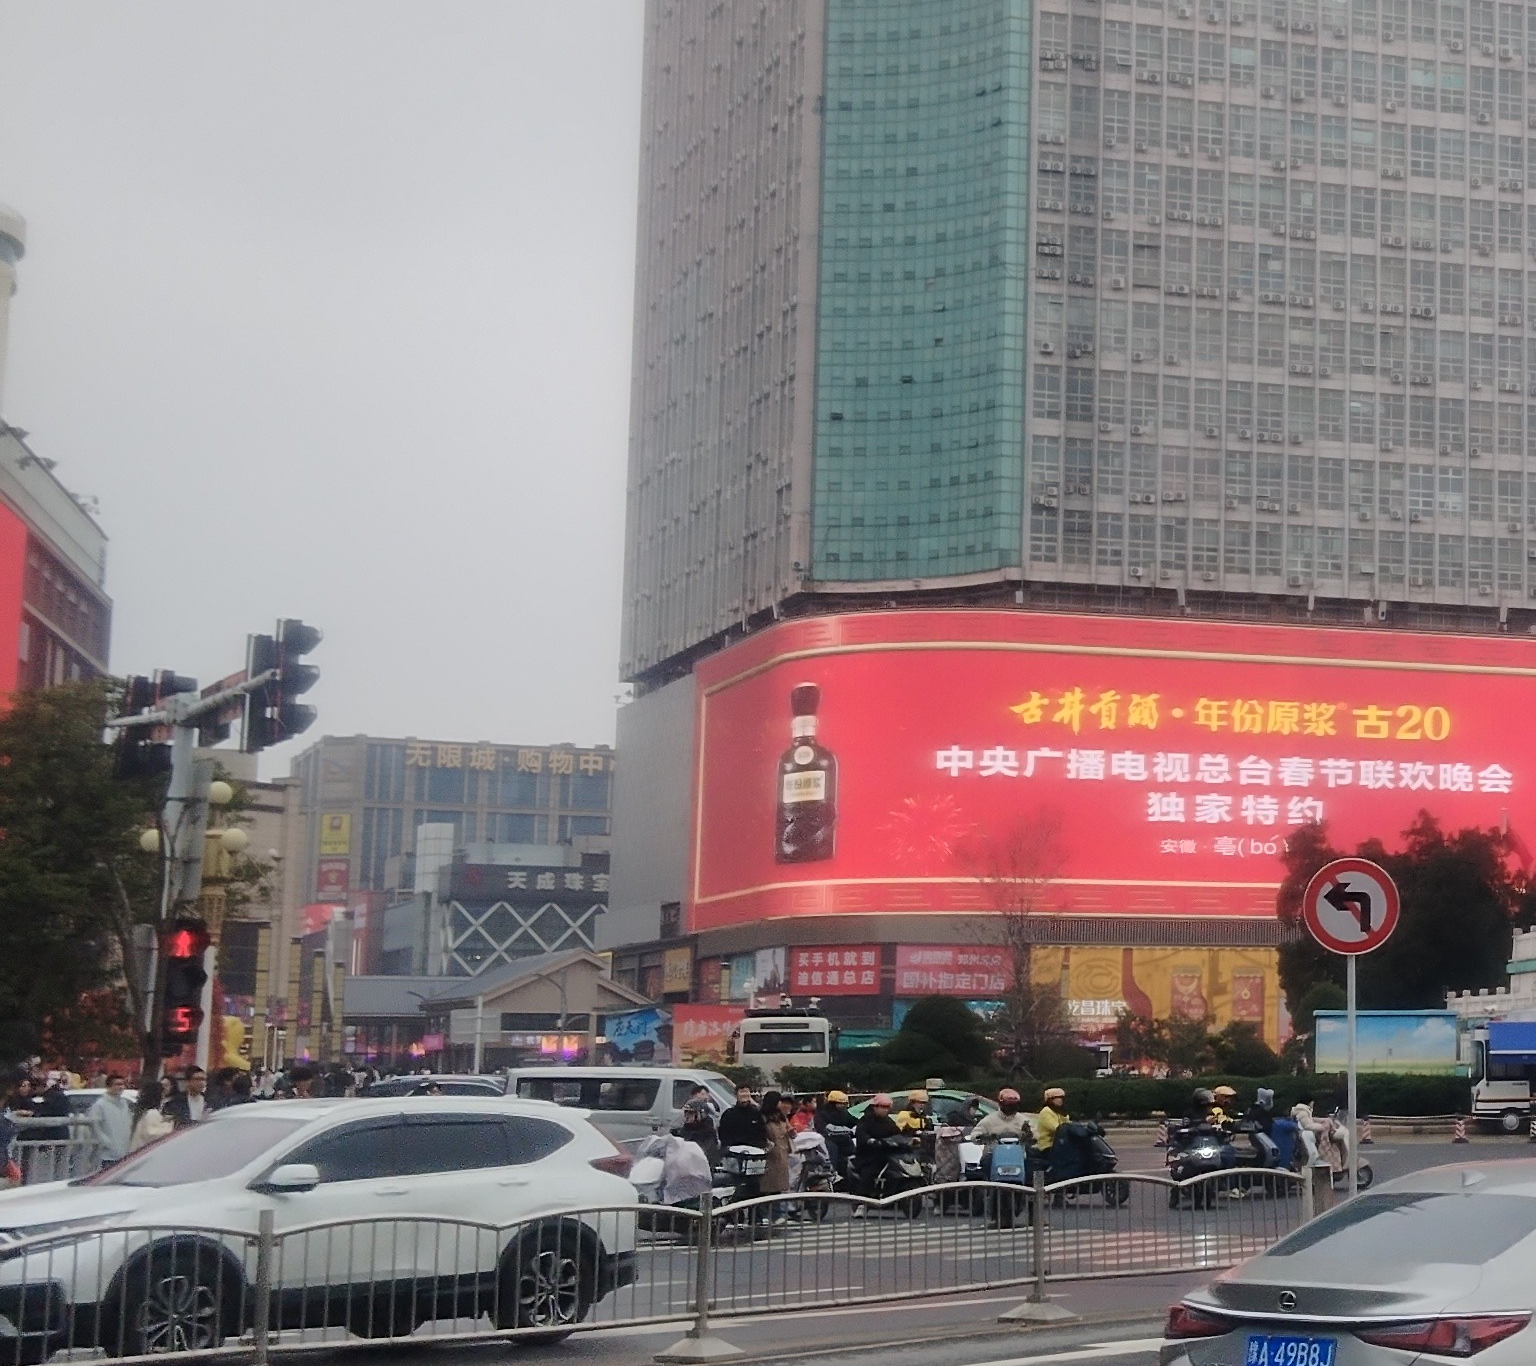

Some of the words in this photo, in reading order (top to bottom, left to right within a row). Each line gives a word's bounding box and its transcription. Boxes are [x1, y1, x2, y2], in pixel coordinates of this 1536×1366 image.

[406, 742, 615, 776] 无限城·购物中
[936, 745, 1514, 794] 中央广播电视总台春节联欢晚会
[1147, 791, 1325, 826] 独家特约
[797, 950, 876, 967] 买手机就到
[902, 971, 1006, 991] 国补指定门店
